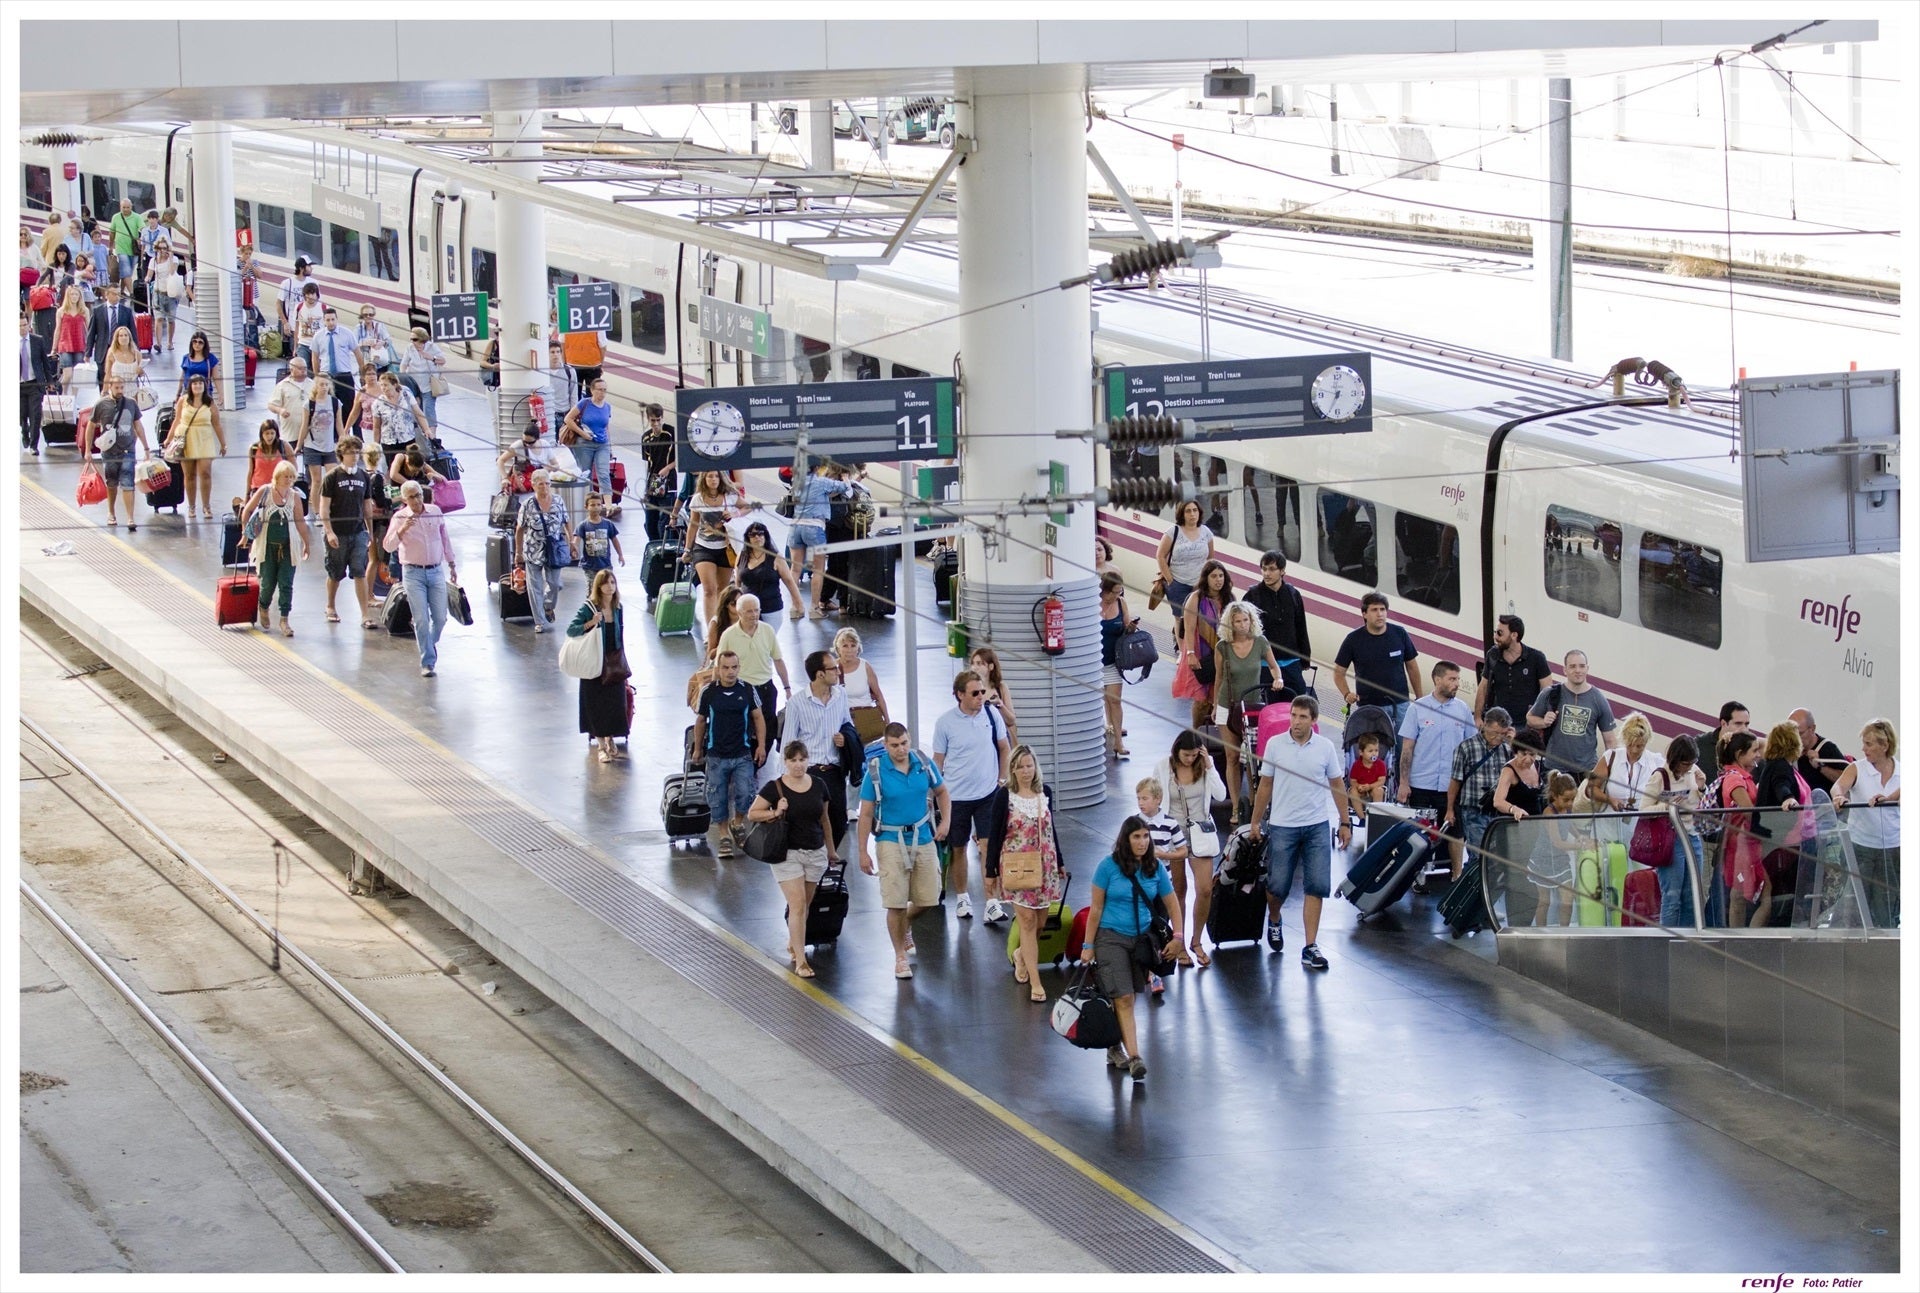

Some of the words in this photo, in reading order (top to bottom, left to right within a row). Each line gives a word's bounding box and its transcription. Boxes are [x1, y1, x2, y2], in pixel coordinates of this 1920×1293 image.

[1163, 374, 1181, 383] Hora
[1208, 372, 1224, 380] Tren
[1226, 371, 1241, 379] TRAIN
[1131, 377, 1144, 386] Vía
[904, 389, 916, 399] Vía
[749, 397, 767, 405] Hora
[796, 395, 813, 403] Tren
[1164, 398, 1191, 407] Destino
[1193, 398, 1225, 406] DESTINATION
[750, 422, 778, 431] Destino
[896, 414, 938, 451] 11
[337, 479, 350, 487] ZOO
[350, 479, 365, 487] YORK
[1440, 483, 1466, 506] renfe
[1800, 594, 1861, 642] renfe
[1843, 647, 1874, 679] Alvia
